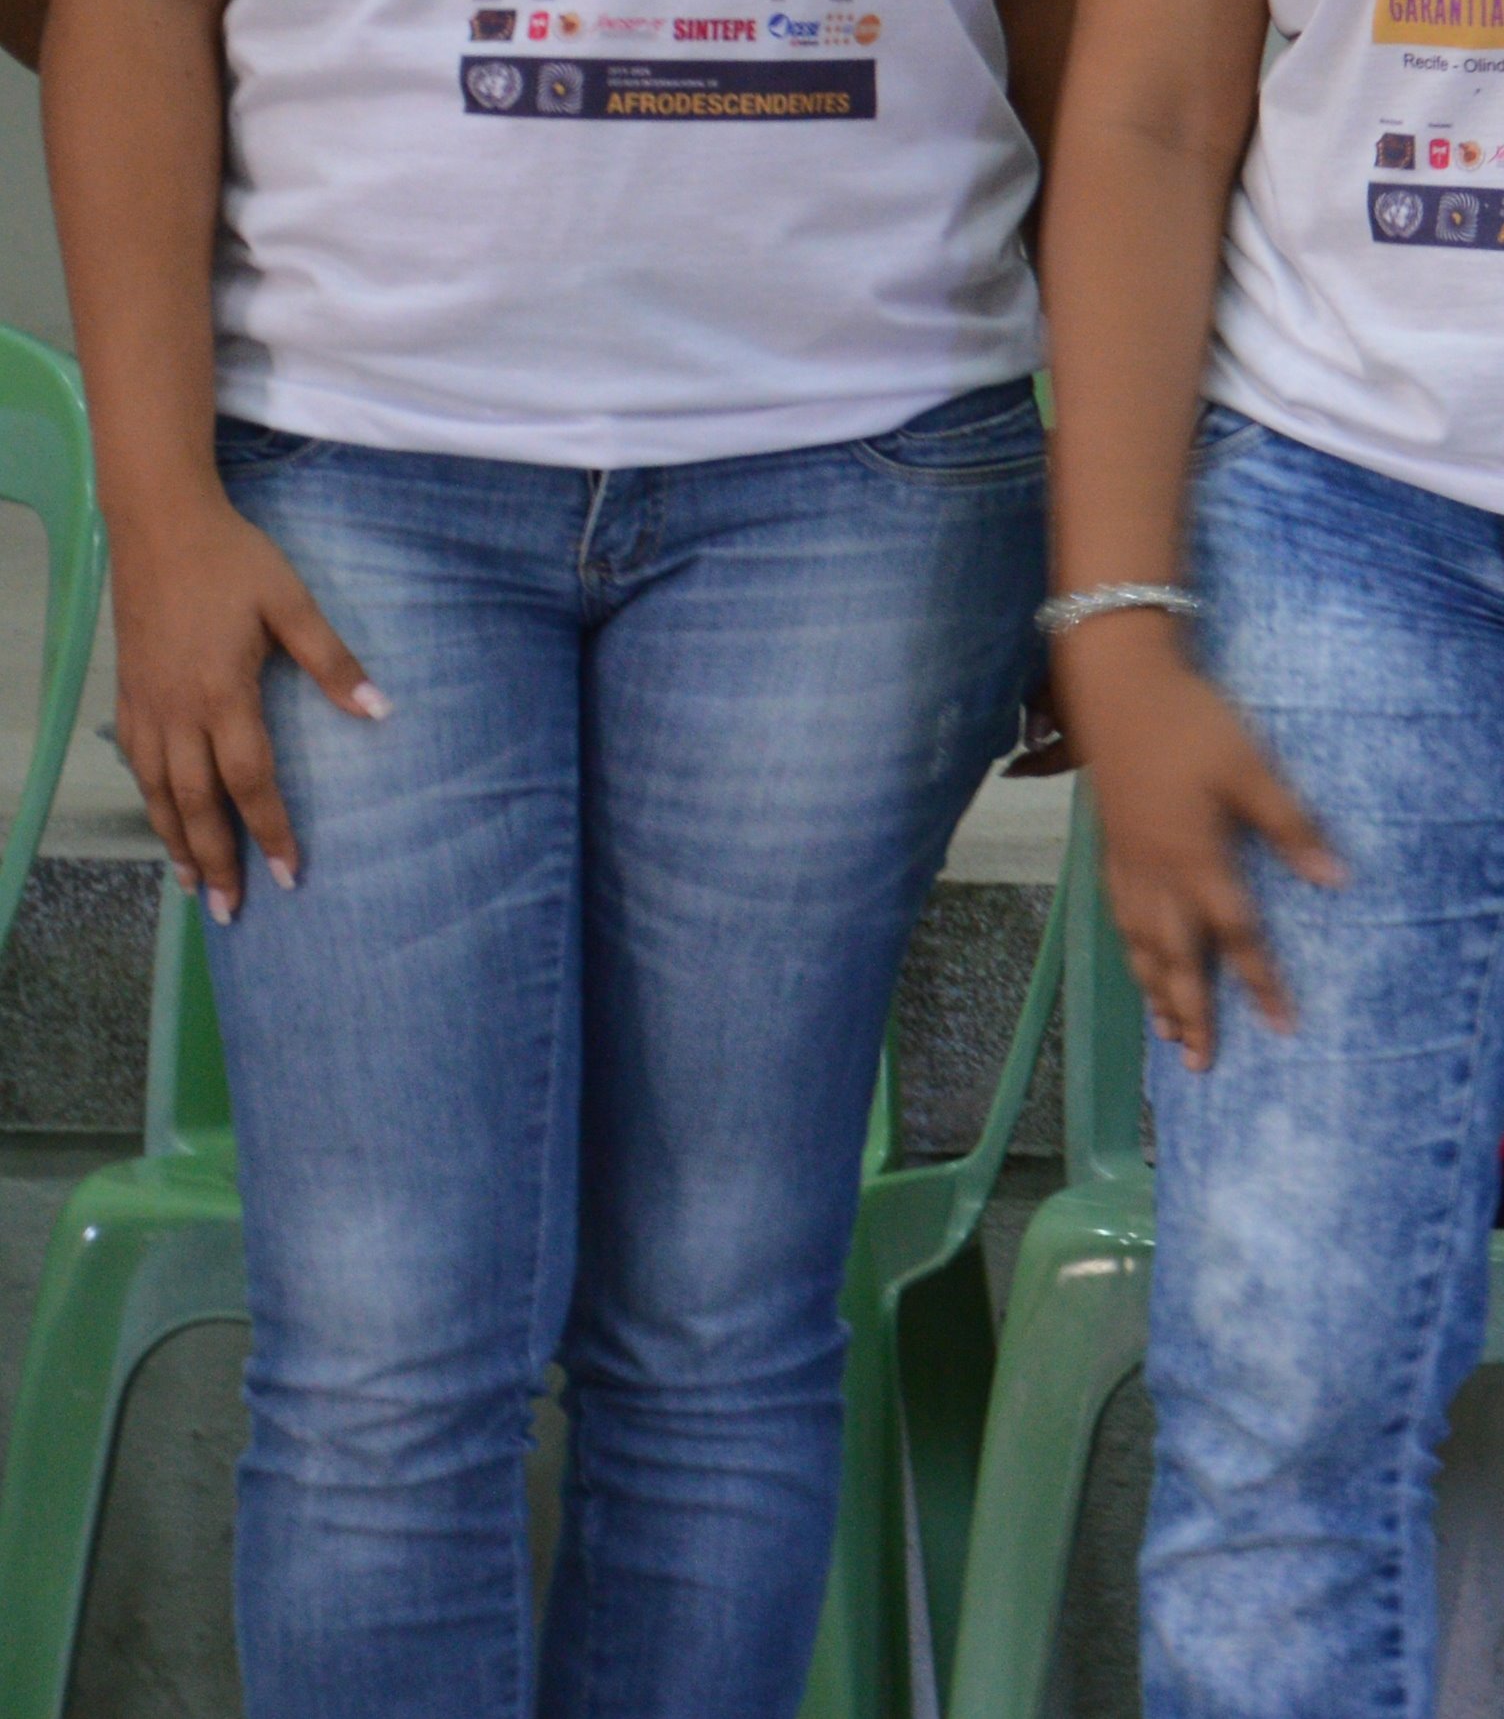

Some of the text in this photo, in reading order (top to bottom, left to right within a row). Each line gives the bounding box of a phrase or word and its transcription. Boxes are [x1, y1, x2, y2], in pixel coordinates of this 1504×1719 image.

[673, 17, 757, 42] SINTEPE
[1403, 53, 1449, 72] Recife
[606, 91, 851, 115] AFRODESCENDENTES
